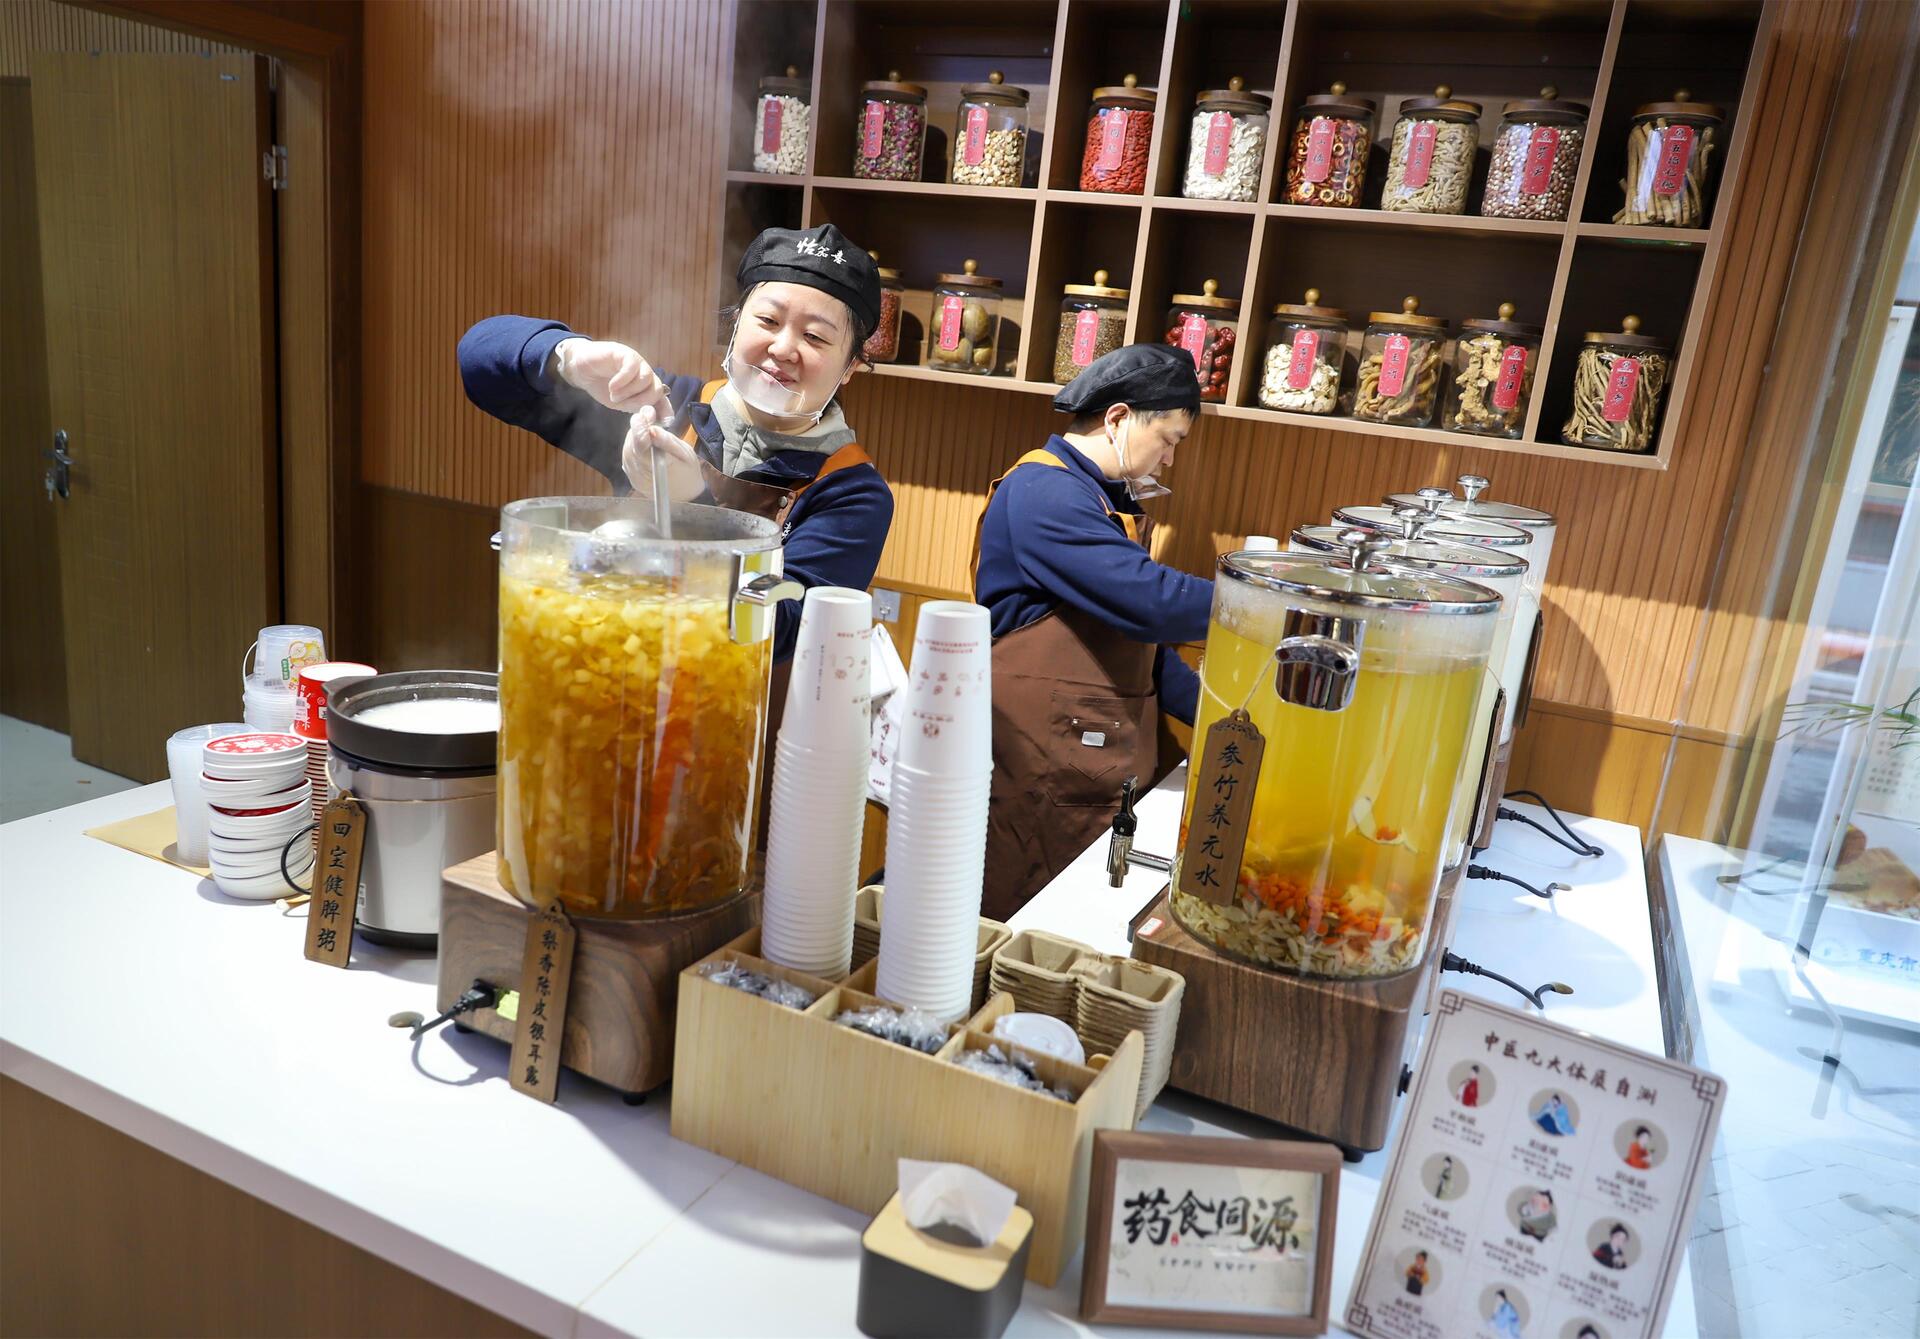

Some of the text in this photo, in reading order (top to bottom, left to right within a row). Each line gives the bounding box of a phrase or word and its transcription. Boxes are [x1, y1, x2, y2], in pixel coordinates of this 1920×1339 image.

[1195, 742, 1244, 888] 参竹养元水
[316, 821, 352, 952] 四宝健脾粥
[1484, 1030, 1658, 1106] 中医九大体质自测
[1122, 1187, 1300, 1254] 药食同源
